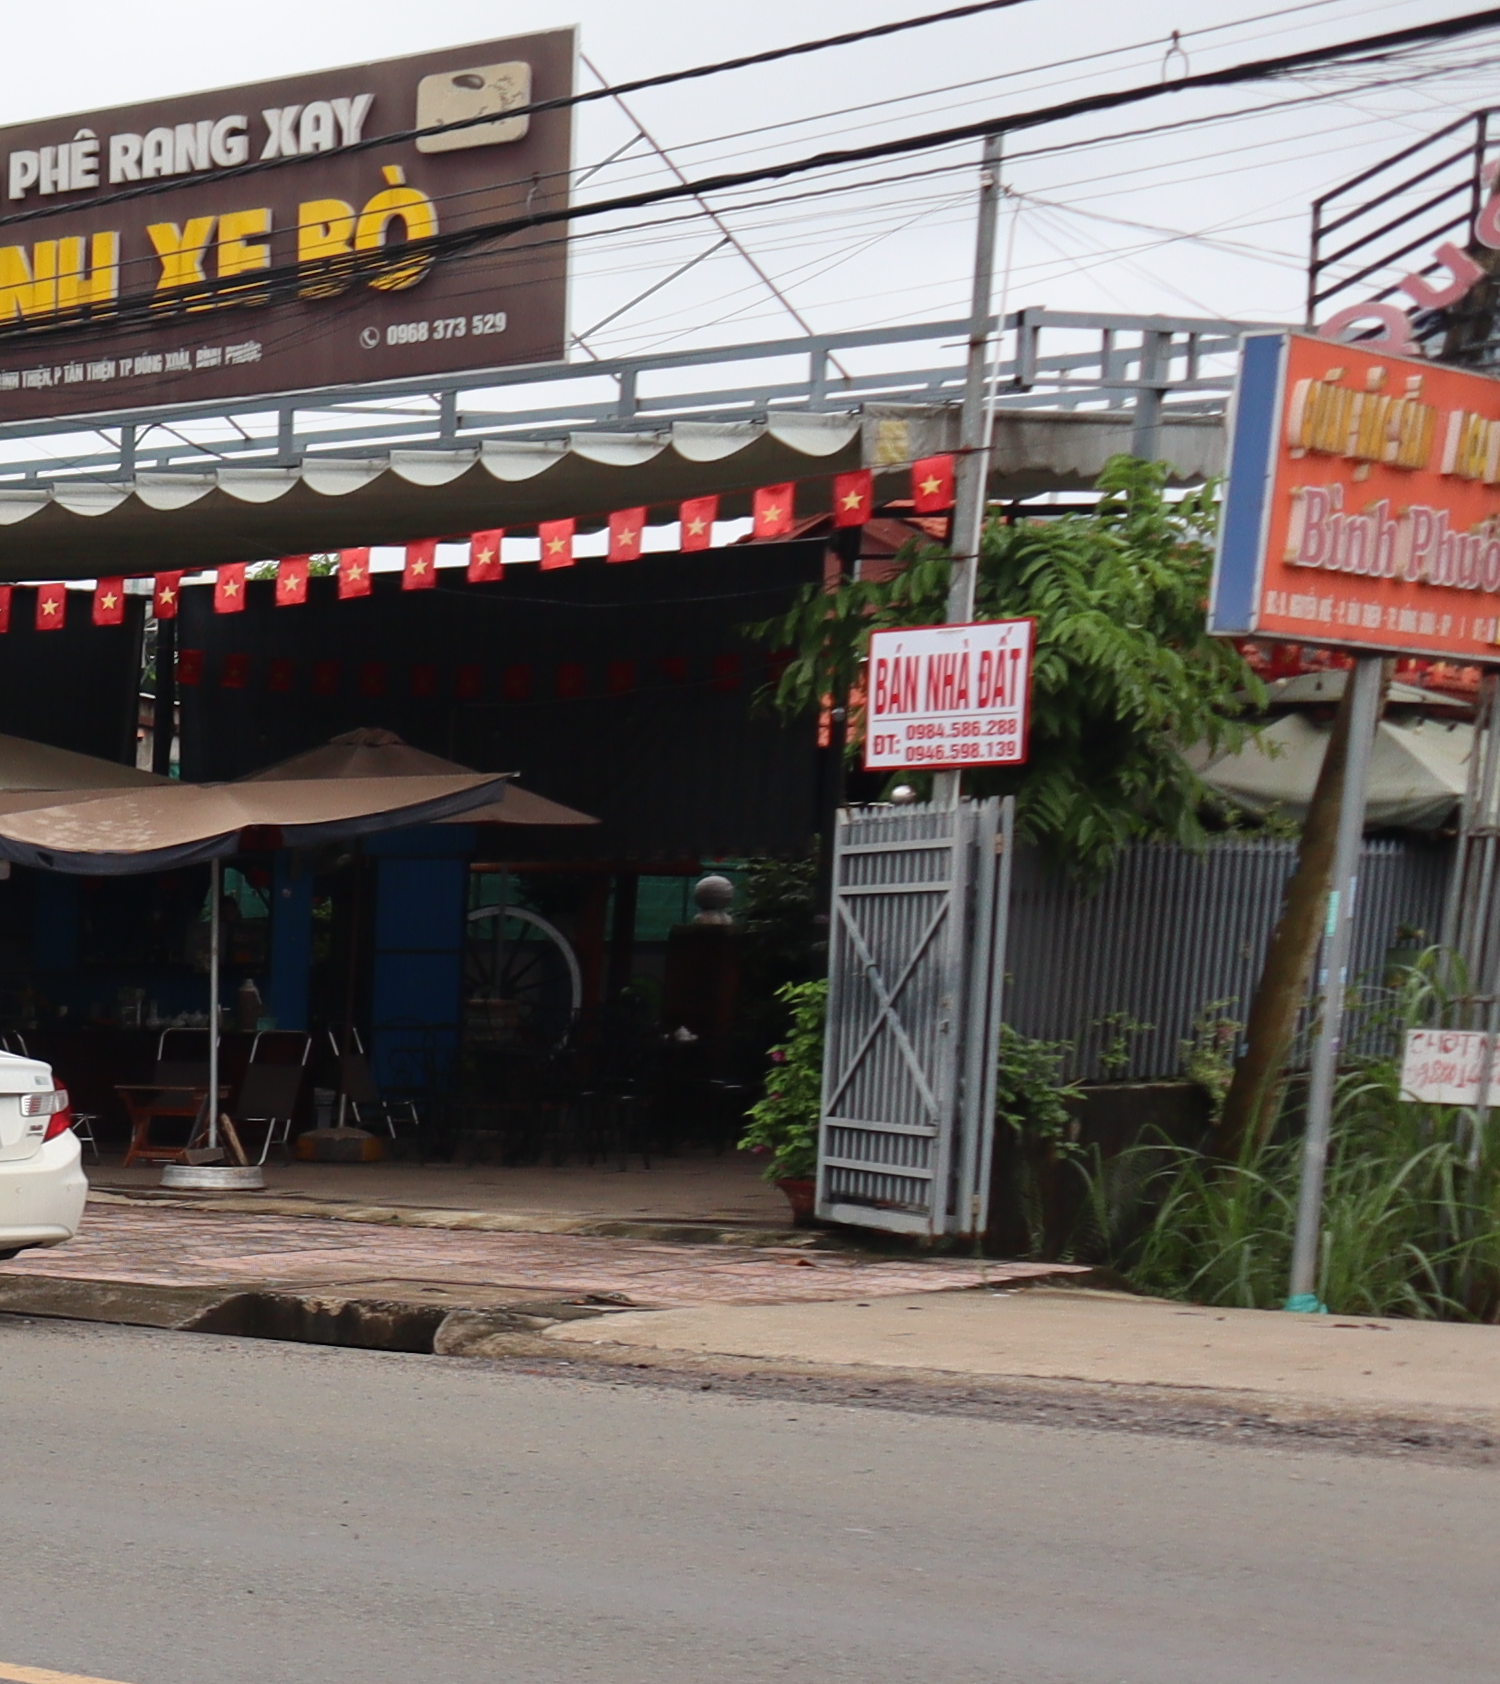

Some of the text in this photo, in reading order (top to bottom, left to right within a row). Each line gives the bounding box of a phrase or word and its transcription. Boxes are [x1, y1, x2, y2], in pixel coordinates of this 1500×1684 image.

[8, 128, 100, 200] PHÊ
[109, 114, 250, 184] RANG
[261, 93, 375, 161] XAY
[147, 207, 274, 316] XE
[298, 165, 440, 299] BÒ
[386, 311, 507, 346] 0968 373 529
[1286, 483, 1396, 579] Bình
[875, 627, 1022, 715] BÁN NHÀ ĐẤT
[872, 718, 1017, 756] ĐT: 0984.586.288
[905, 740, 1016, 762] 0946.598.139
